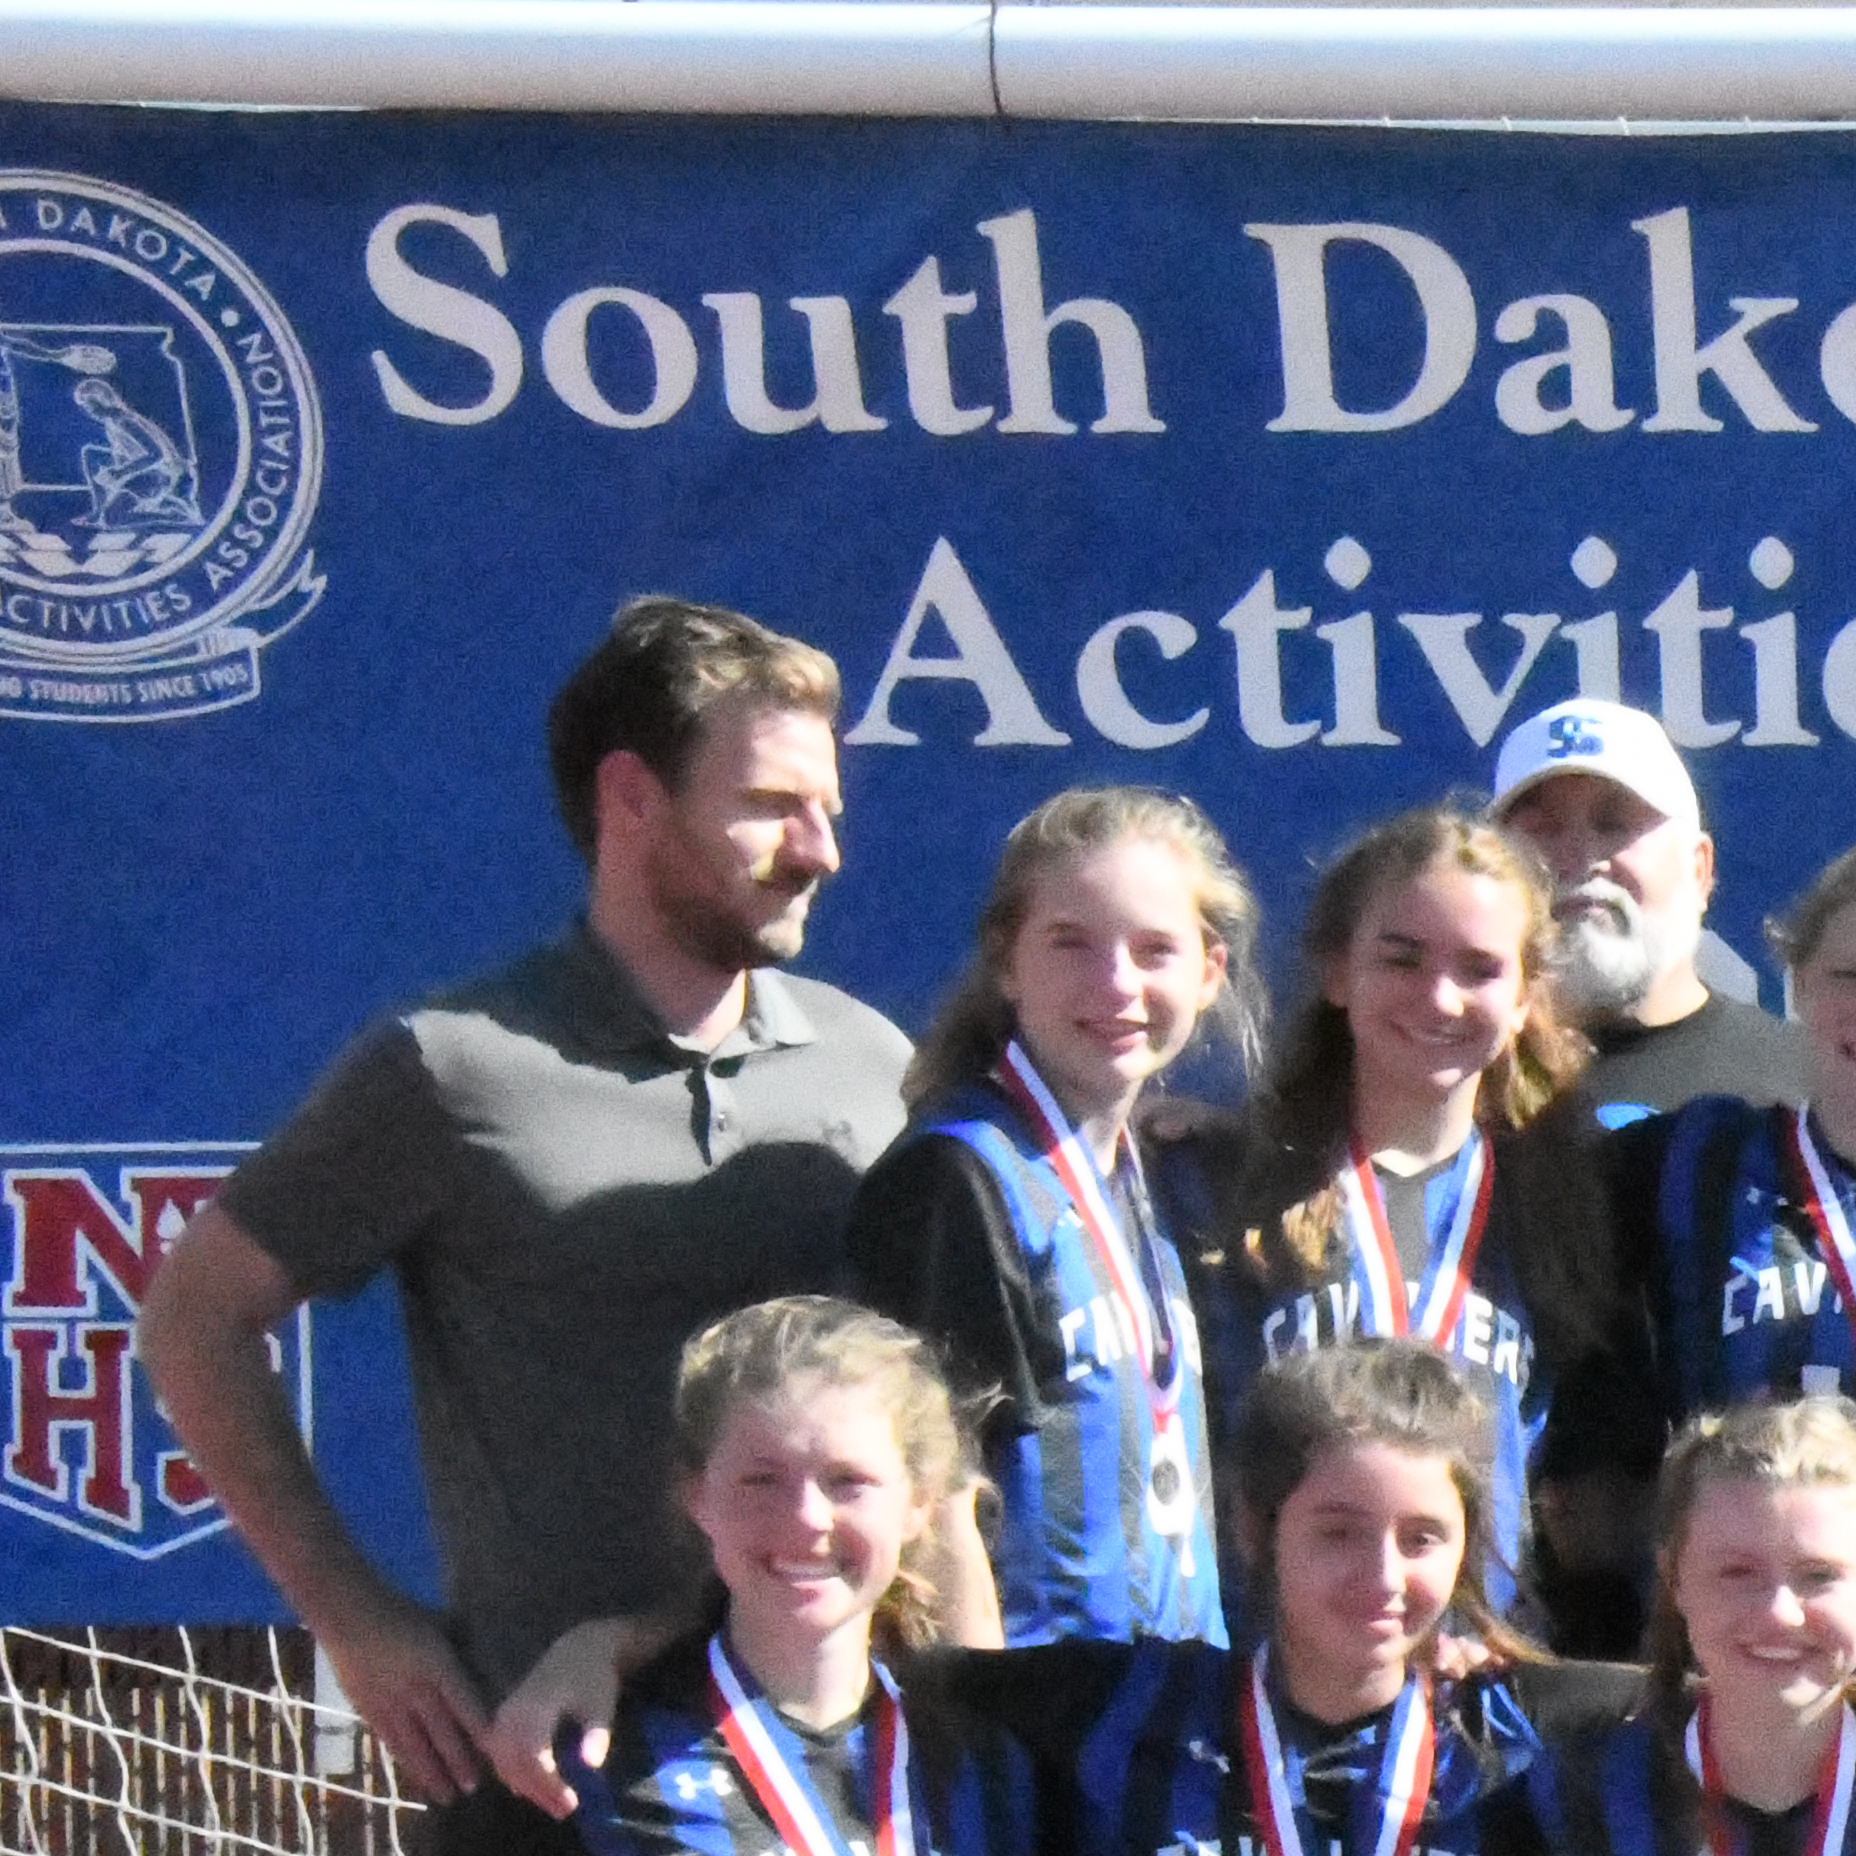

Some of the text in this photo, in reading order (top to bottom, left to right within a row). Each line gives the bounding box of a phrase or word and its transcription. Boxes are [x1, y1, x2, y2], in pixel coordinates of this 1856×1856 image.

[38, 199, 217, 300] DAKOTA
[364, 203, 1165, 436] South
[0, 331, 293, 633] CTIVITIES ASSOCIATION
